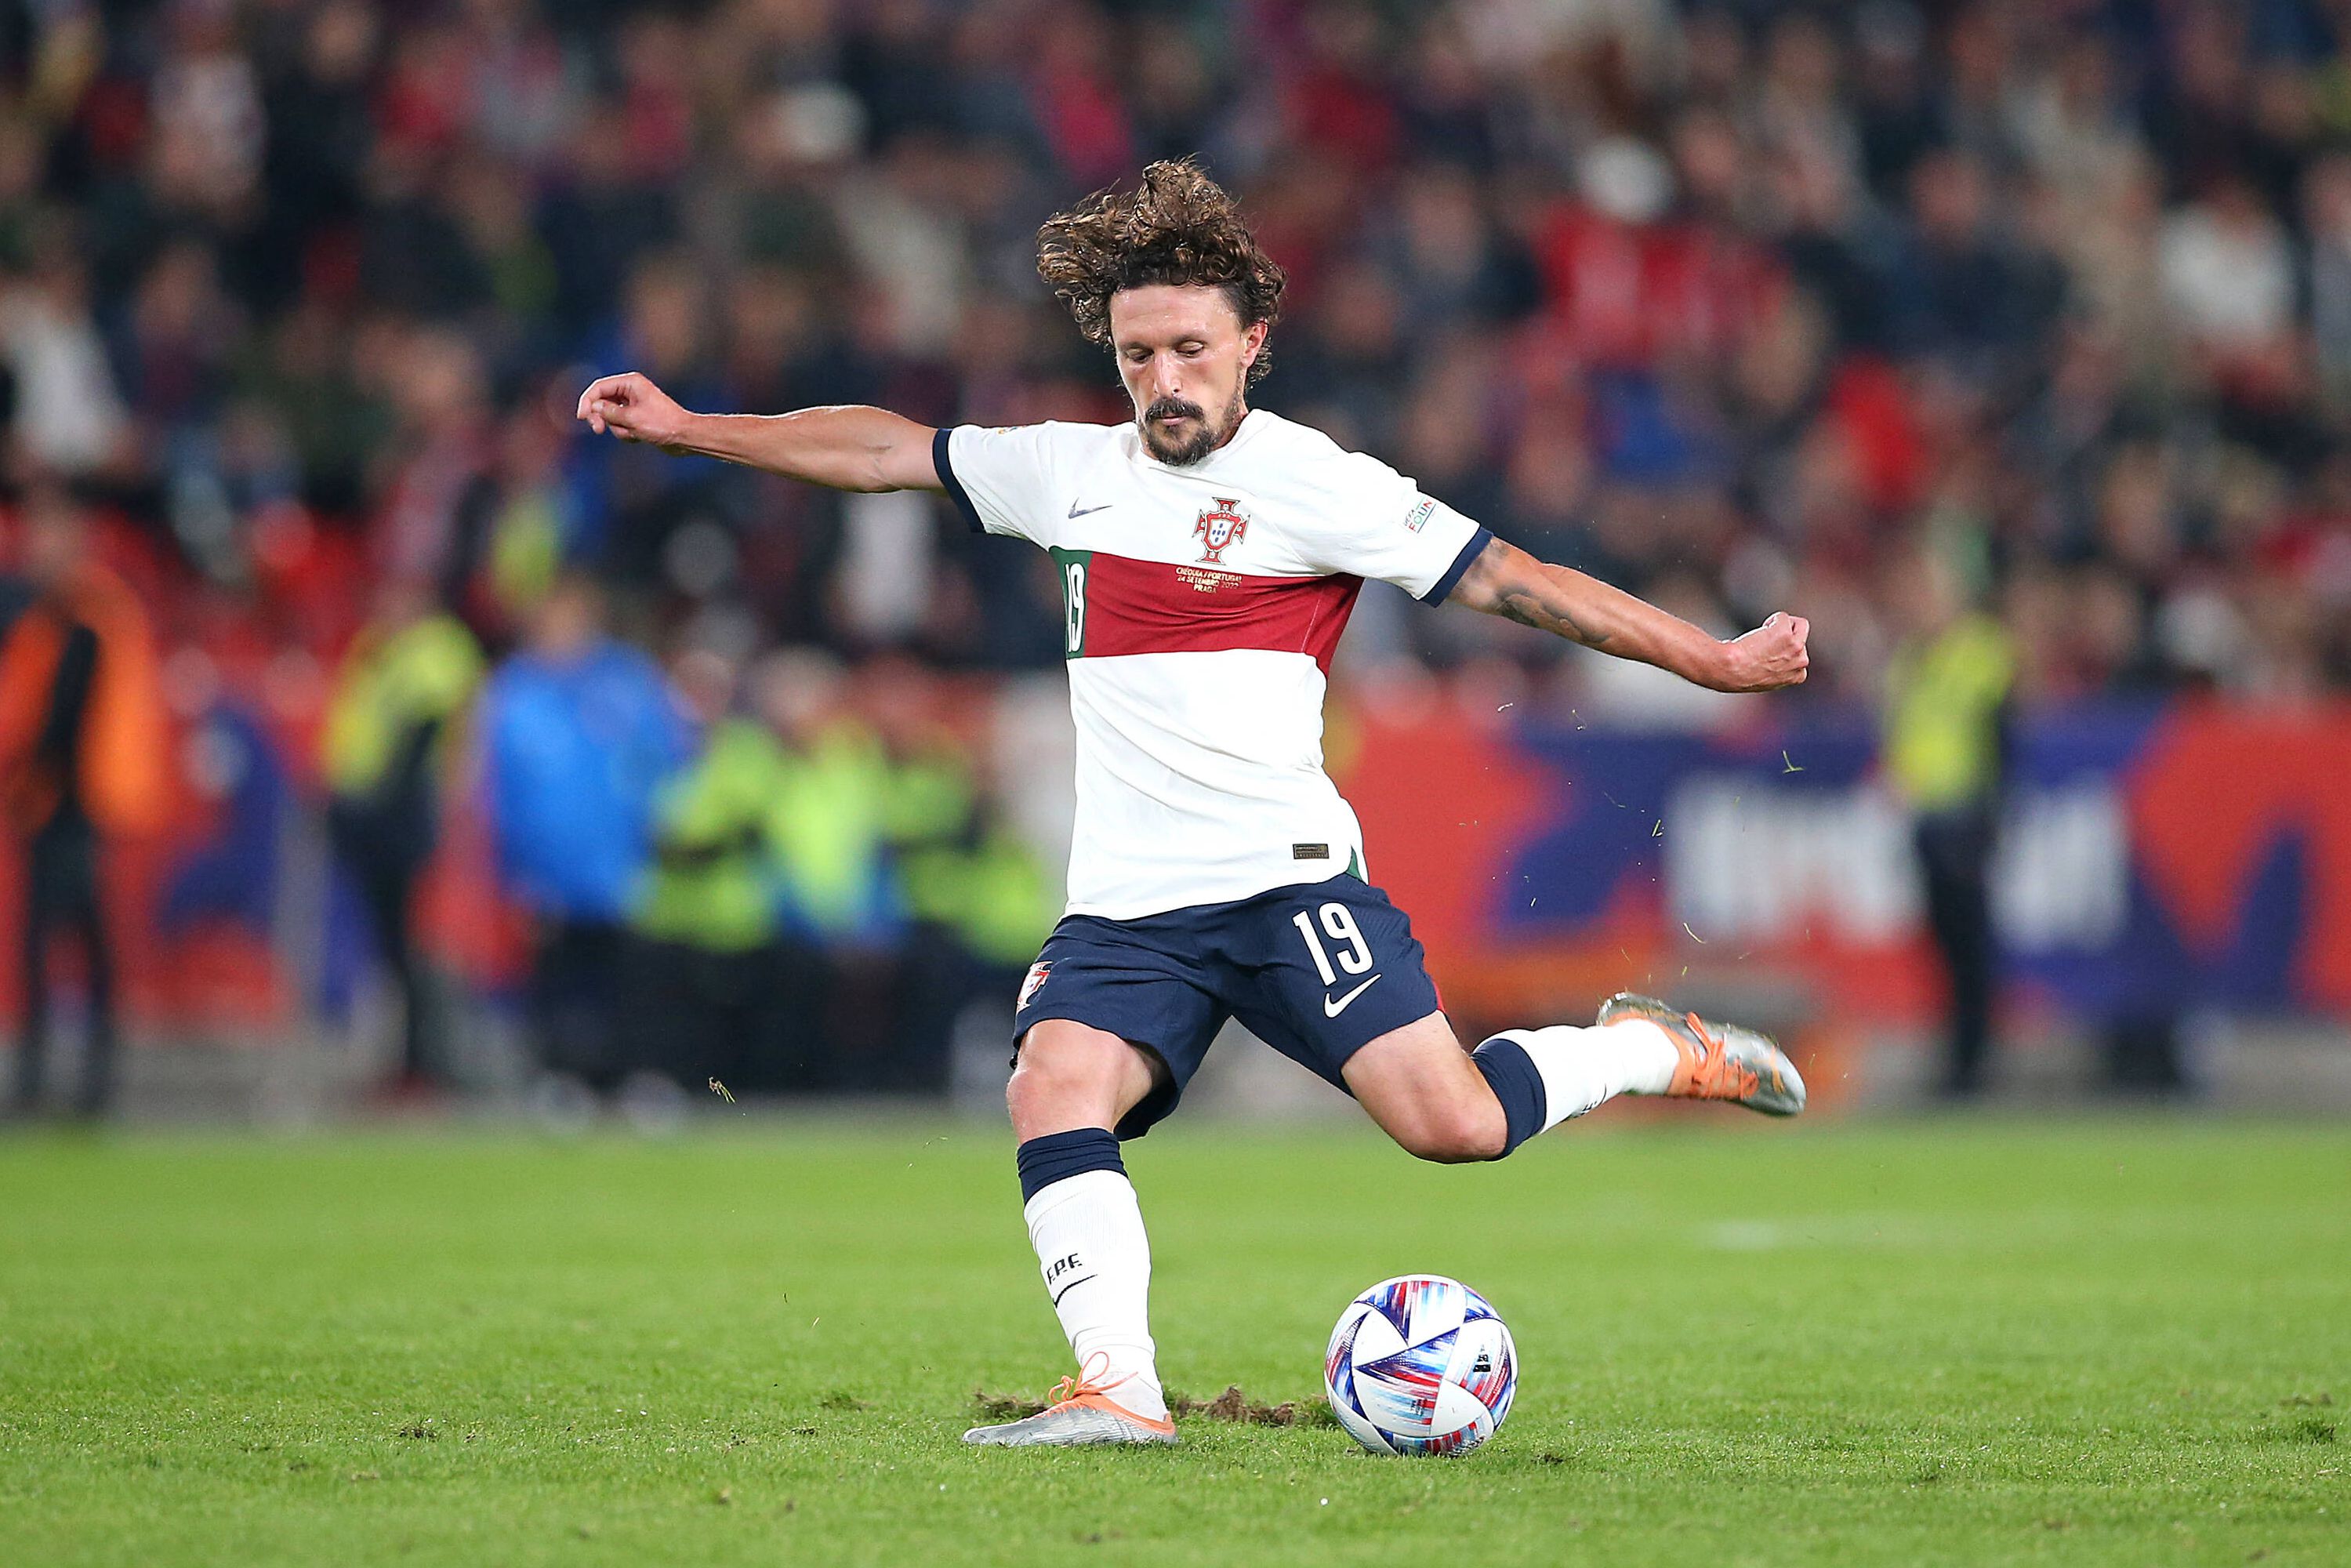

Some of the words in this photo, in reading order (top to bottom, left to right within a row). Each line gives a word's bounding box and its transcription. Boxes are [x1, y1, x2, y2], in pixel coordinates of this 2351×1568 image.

[1065, 562, 1085, 652] 19
[1193, 583, 1217, 593] PRAGA
[1292, 902, 1373, 986] 19
